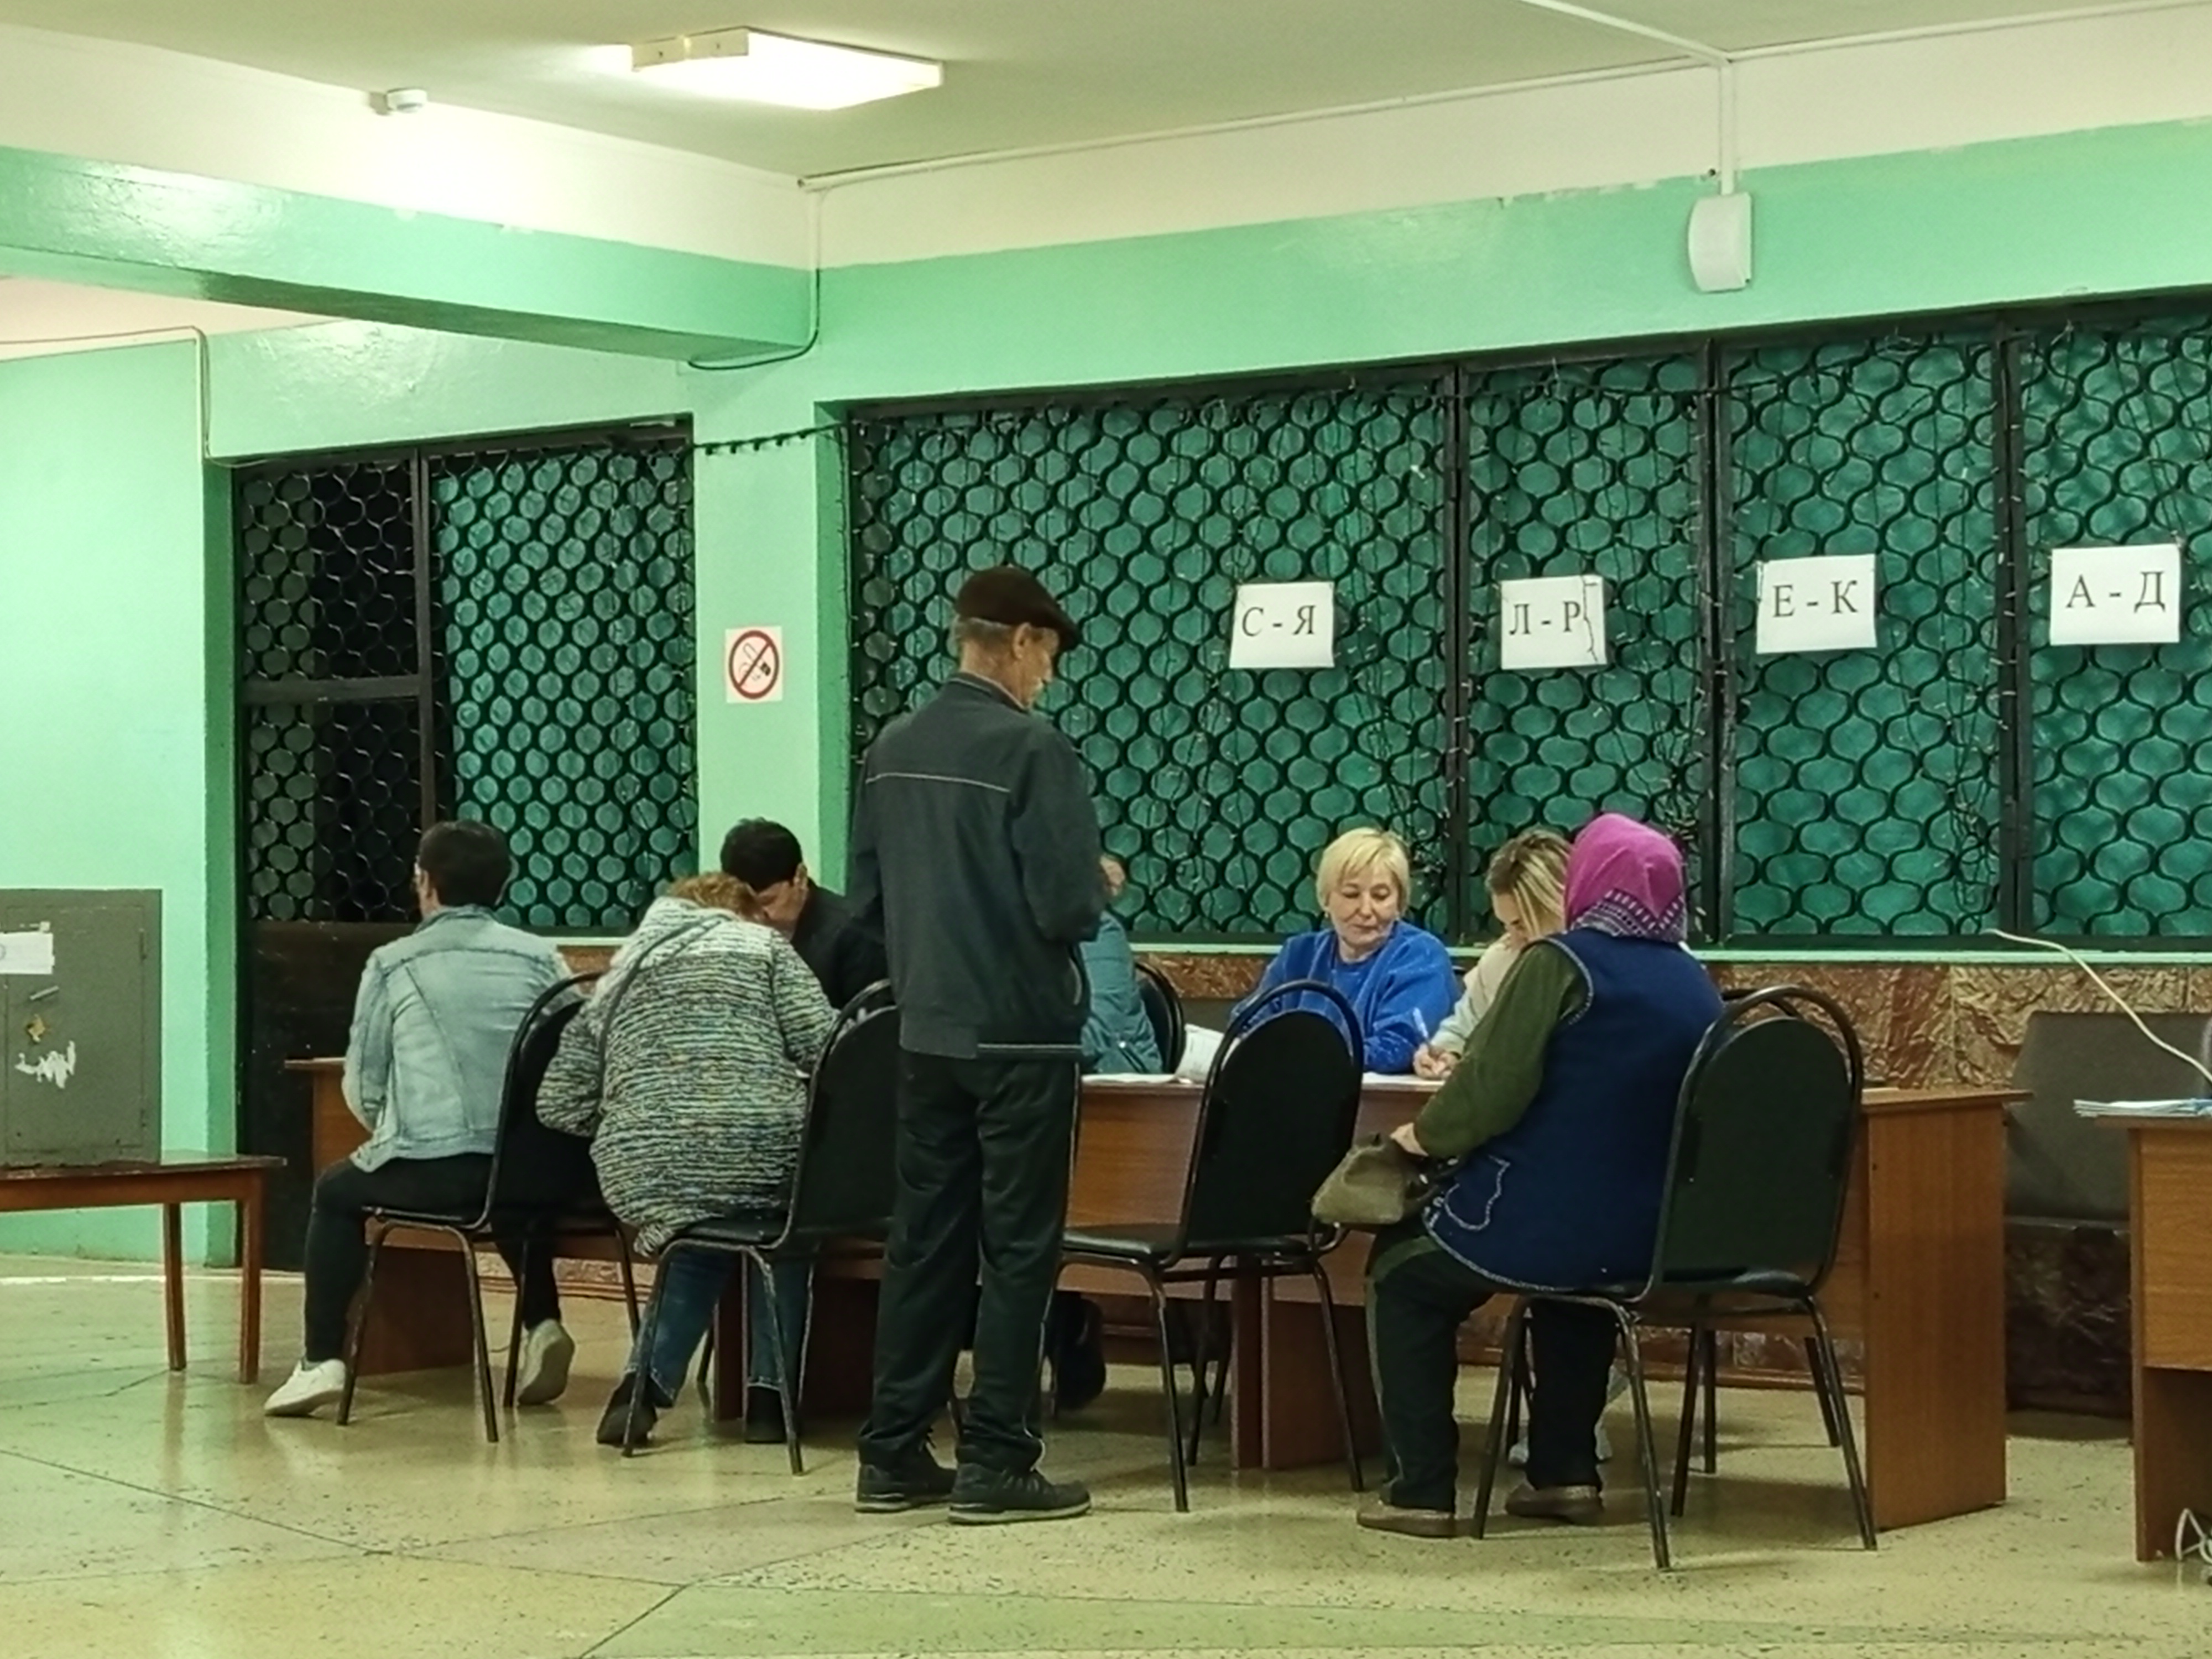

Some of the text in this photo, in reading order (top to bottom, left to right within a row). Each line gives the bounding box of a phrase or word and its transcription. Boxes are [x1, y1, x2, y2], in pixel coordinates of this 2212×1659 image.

[1773, 585, 1794, 618] Е
[1831, 580, 1859, 615] К
[2065, 575, 2096, 609] А
[2133, 571, 2166, 613] Д
[1241, 606, 1264, 637] С
[1293, 605, 1316, 635] Я
[1509, 603, 1531, 635] Л
[1562, 601, 1581, 633] Р
